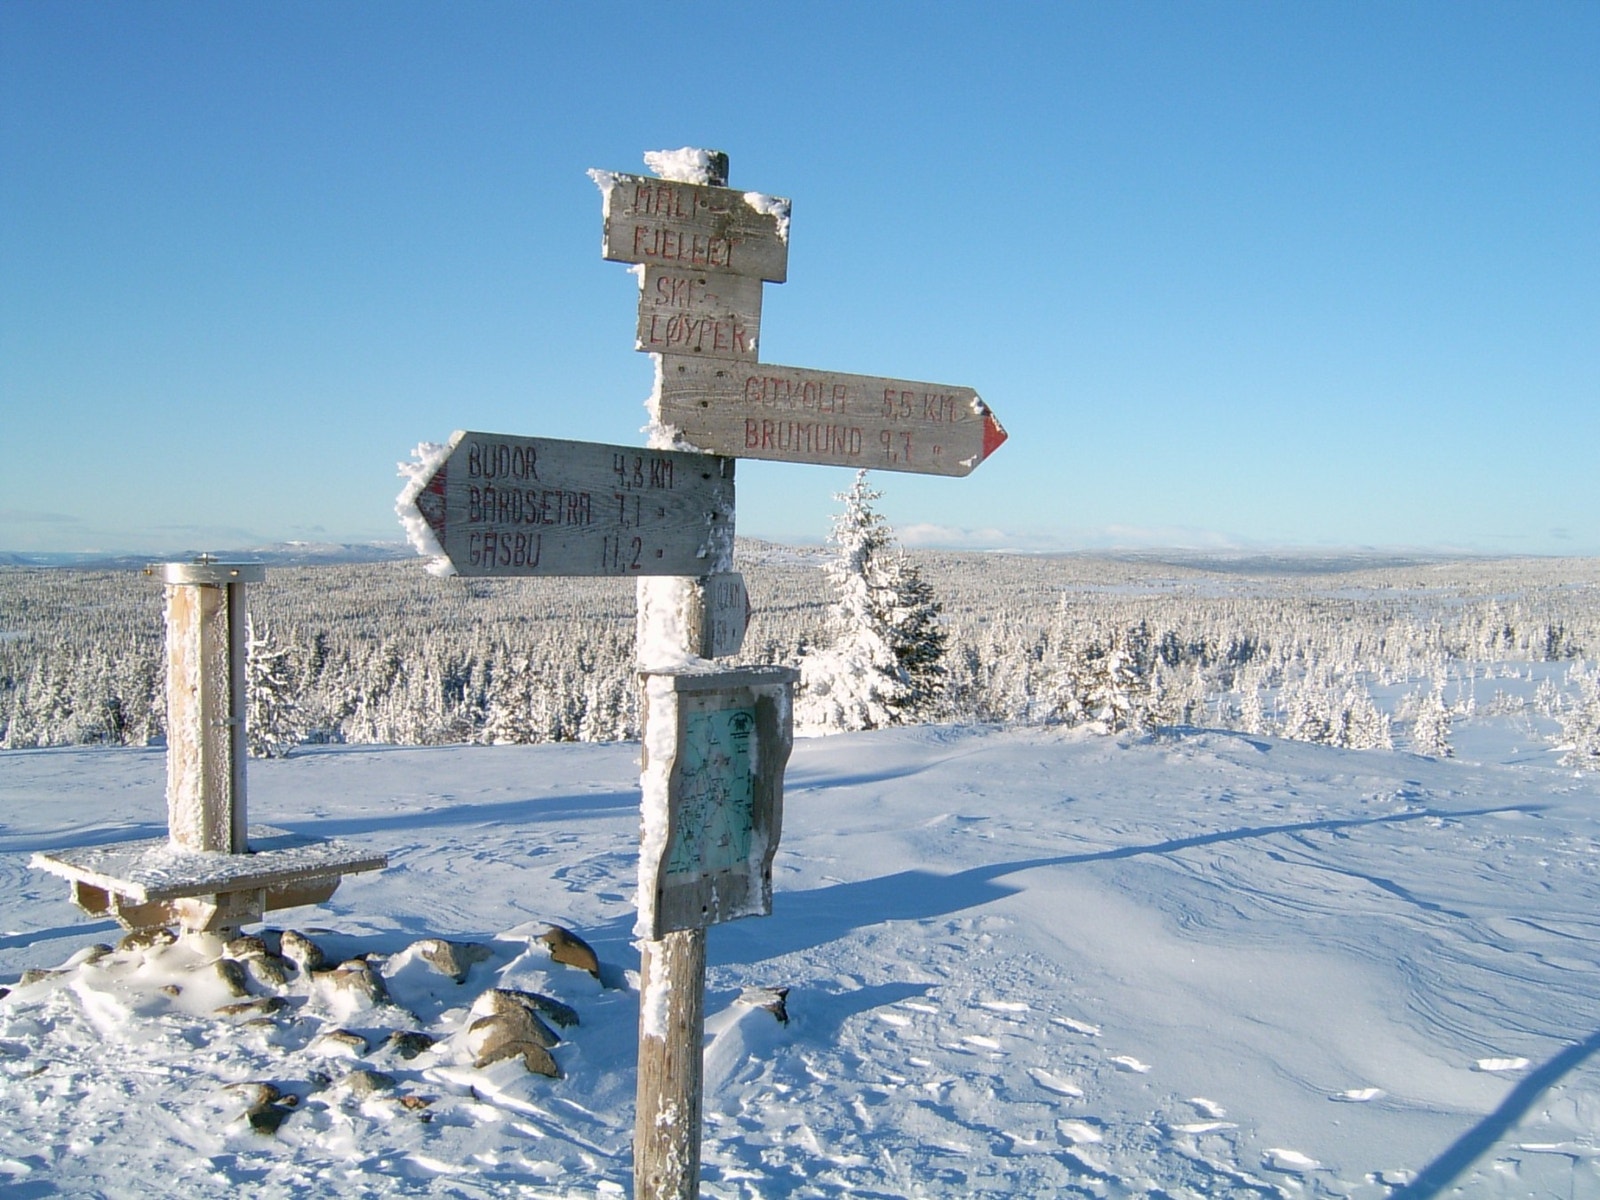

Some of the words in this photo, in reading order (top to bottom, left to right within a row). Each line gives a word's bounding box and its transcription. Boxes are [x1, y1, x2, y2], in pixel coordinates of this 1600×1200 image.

[633, 224, 742, 267] FJELLET
[650, 313, 746, 353] LØYPER
[744, 376, 847, 414] GITVOLA
[923, 393, 957, 423] KM
[744, 418, 862, 456] BRUMUND
[880, 429, 912, 464] 9,7
[468, 441, 538, 480] BUDOR
[613, 453, 644, 491] 4,8
[649, 458, 673, 489] KM
[613, 491, 640, 530] 7,1
[601, 535, 643, 573] 11,2
